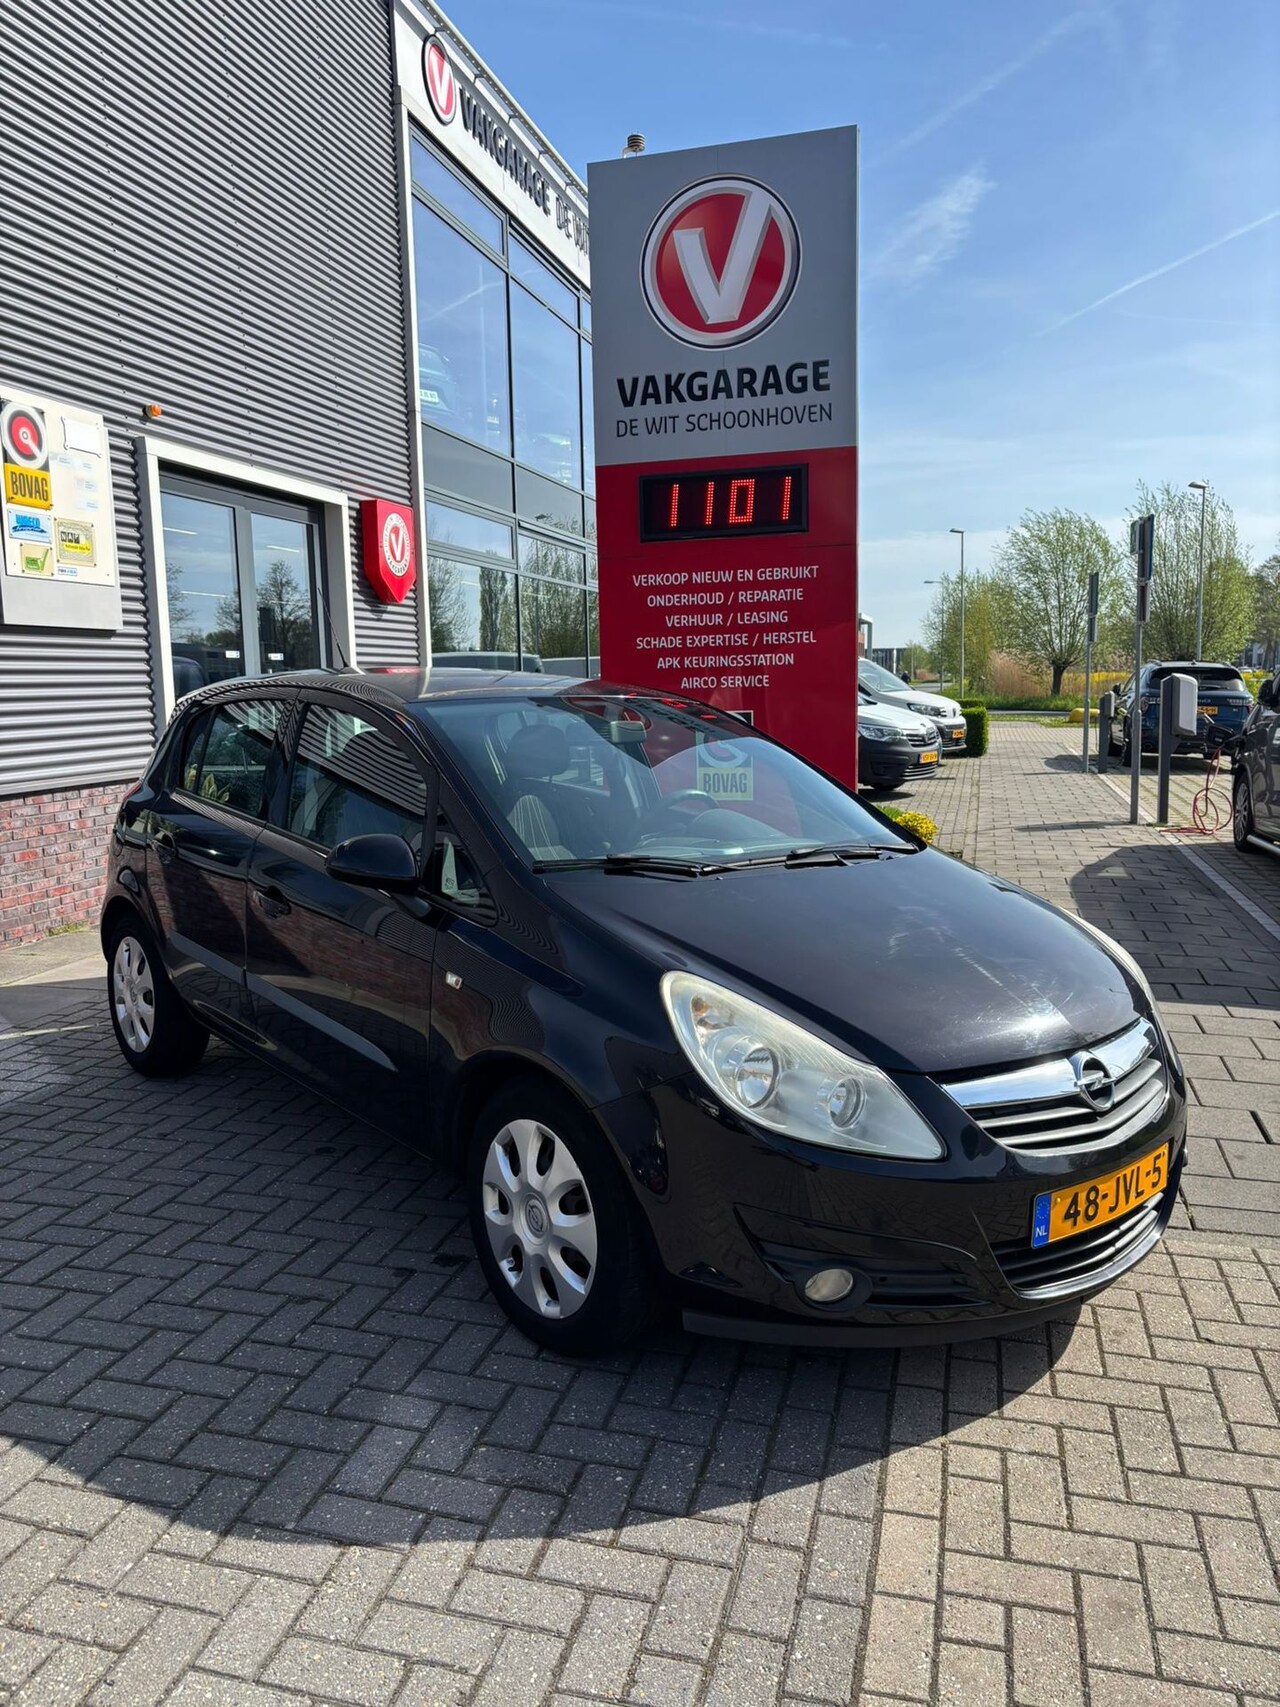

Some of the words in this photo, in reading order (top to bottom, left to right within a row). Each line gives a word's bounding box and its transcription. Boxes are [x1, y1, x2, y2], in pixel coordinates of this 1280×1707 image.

[459, 86, 551, 218] VAKGARAGE
[556, 194, 573, 240] DE
[616, 359, 831, 408] VAKGARAGE
[616, 418, 639, 438] DE
[645, 415, 680, 435] WIT
[685, 402, 832, 433] SCHOONHOVEN
[10, 471, 49, 502] BOVAG
[632, 572, 689, 587] VERKOOP
[692, 570, 734, 584] NIEUW
[737, 568, 753, 582] EN
[756, 565, 819, 581] GEBRUIKT
[647, 591, 724, 607] ONDERHOUD
[727, 591, 735, 605] /
[738, 588, 804, 603] REPARATIE
[665, 613, 723, 628] VERHUUR
[726, 612, 734, 626] /
[737, 610, 788, 625] LEASING
[636, 636, 683, 649] SCHADE
[686, 633, 749, 648] EXPERTISE
[752, 633, 759, 647] /
[763, 630, 817, 645] HERSTEL
[657, 657, 681, 669] APK
[684, 652, 794, 668] KEURINGSSTATION
[681, 676, 717, 689] AIRCO
[720, 674, 770, 689] SERVICE
[703, 772, 748, 794] BOVAG
[1063, 1151, 1163, 1227] 48-JVL-5
[1035, 1226, 1048, 1238] NL
